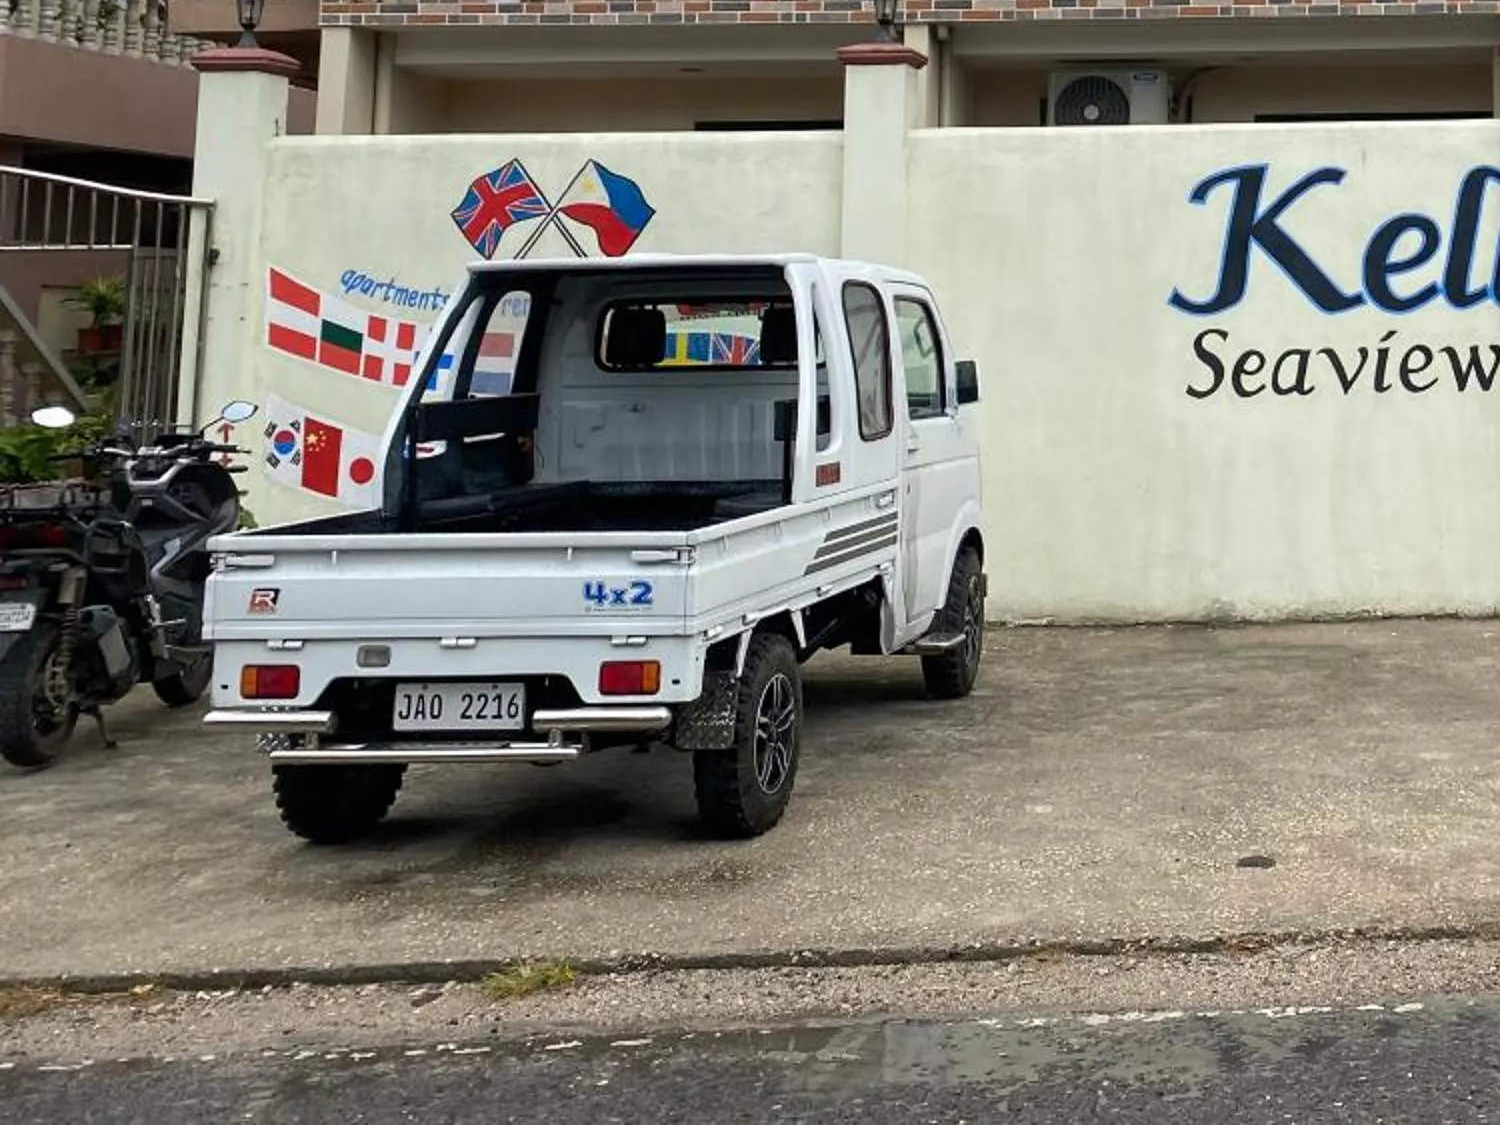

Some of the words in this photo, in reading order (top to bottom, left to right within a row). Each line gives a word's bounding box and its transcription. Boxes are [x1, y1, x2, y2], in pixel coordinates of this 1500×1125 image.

[583, 580, 654, 605] 4x2
[398, 693, 443, 720] JAO
[459, 693, 519, 720] 2216
